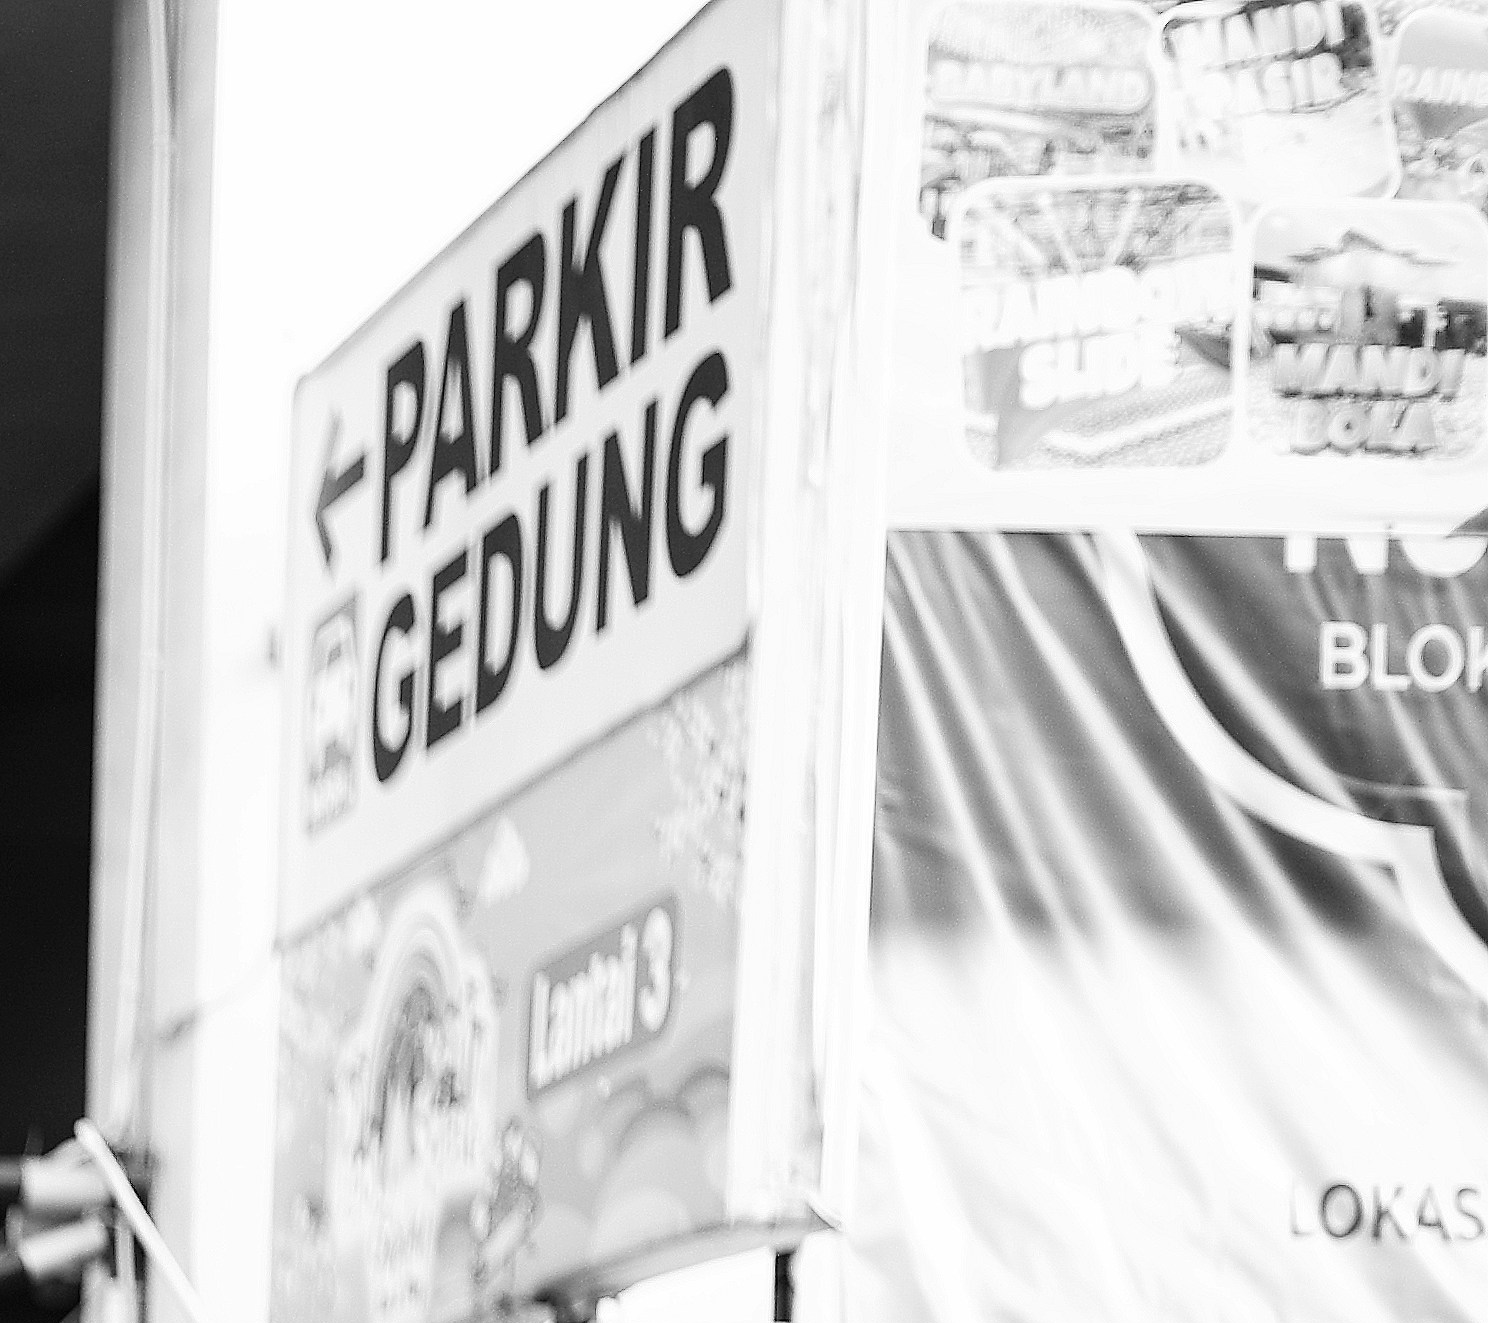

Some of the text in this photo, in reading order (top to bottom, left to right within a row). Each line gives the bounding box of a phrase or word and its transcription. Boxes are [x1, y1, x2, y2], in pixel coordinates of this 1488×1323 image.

[379, 67, 735, 565] PARKIR
[1272, 346, 1467, 400] MANDI
[1290, 401, 1443, 456] BOLA
[371, 352, 730, 783] GEDUNG
[638, 907, 673, 1032] 3
